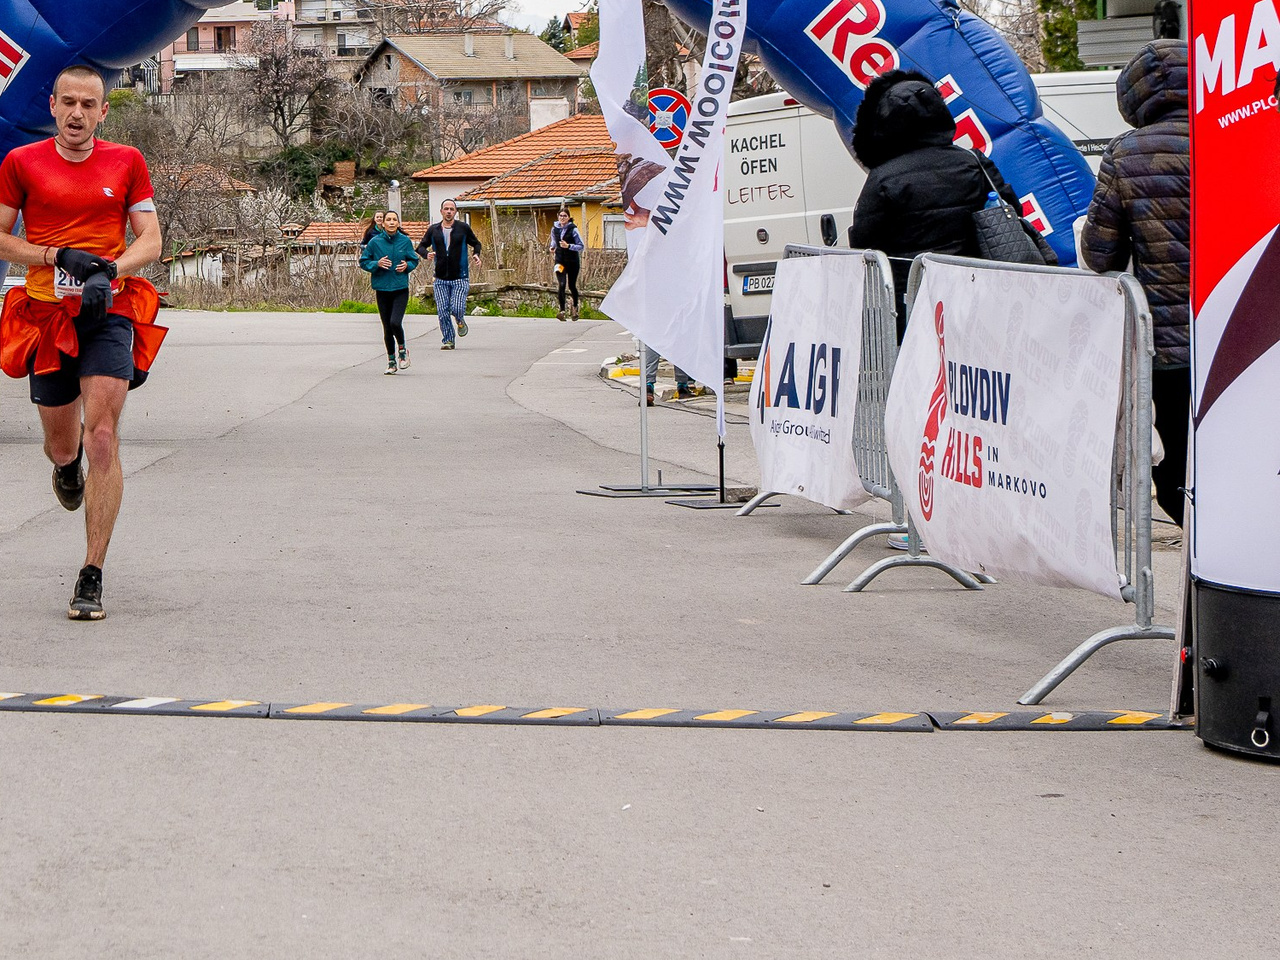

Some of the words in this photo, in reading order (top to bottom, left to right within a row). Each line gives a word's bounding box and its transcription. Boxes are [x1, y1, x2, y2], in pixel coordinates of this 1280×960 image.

[730, 134, 786, 153] KACHEL
[740, 157, 777, 175] ÖFEN
[727, 184, 794, 204] LEITER
[748, 276, 760, 289] PB
[948, 360, 1011, 425] PLOVDIV
[941, 427, 982, 488] HILLS
[987, 446, 999, 462] IN
[988, 471, 1047, 499] MARKOVO
